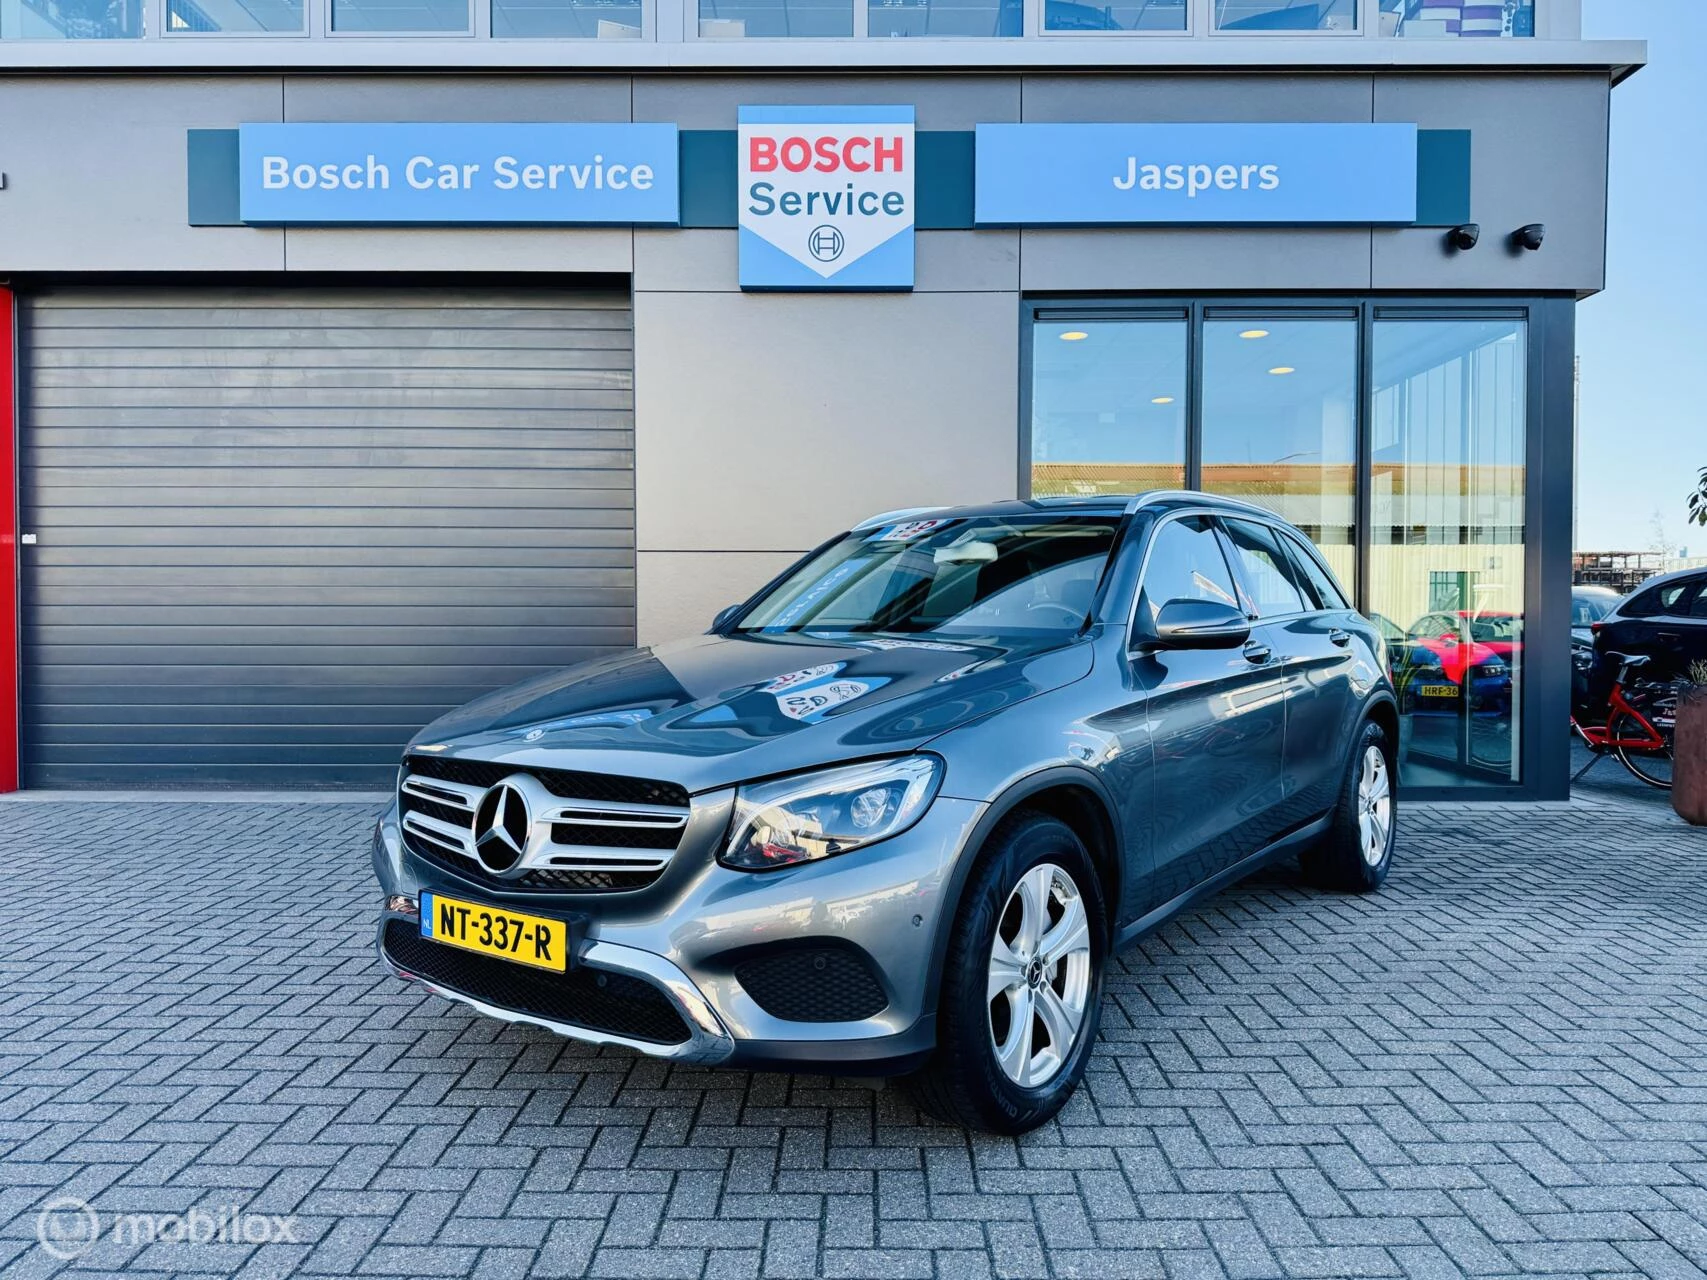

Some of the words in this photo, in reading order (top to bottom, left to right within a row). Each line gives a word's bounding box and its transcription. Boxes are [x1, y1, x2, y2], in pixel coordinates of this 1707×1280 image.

[262, 154, 390, 190] Bosch
[405, 155, 480, 190] Car
[493, 154, 654, 190] Service
[750, 136, 904, 173] BOSCH
[1112, 156, 1280, 198] Jaspers
[748, 181, 905, 217] Service
[1424, 686, 1458, 696] HRF-36
[423, 918, 432, 930] NL
[440, 903, 552, 962] NT-337-R
